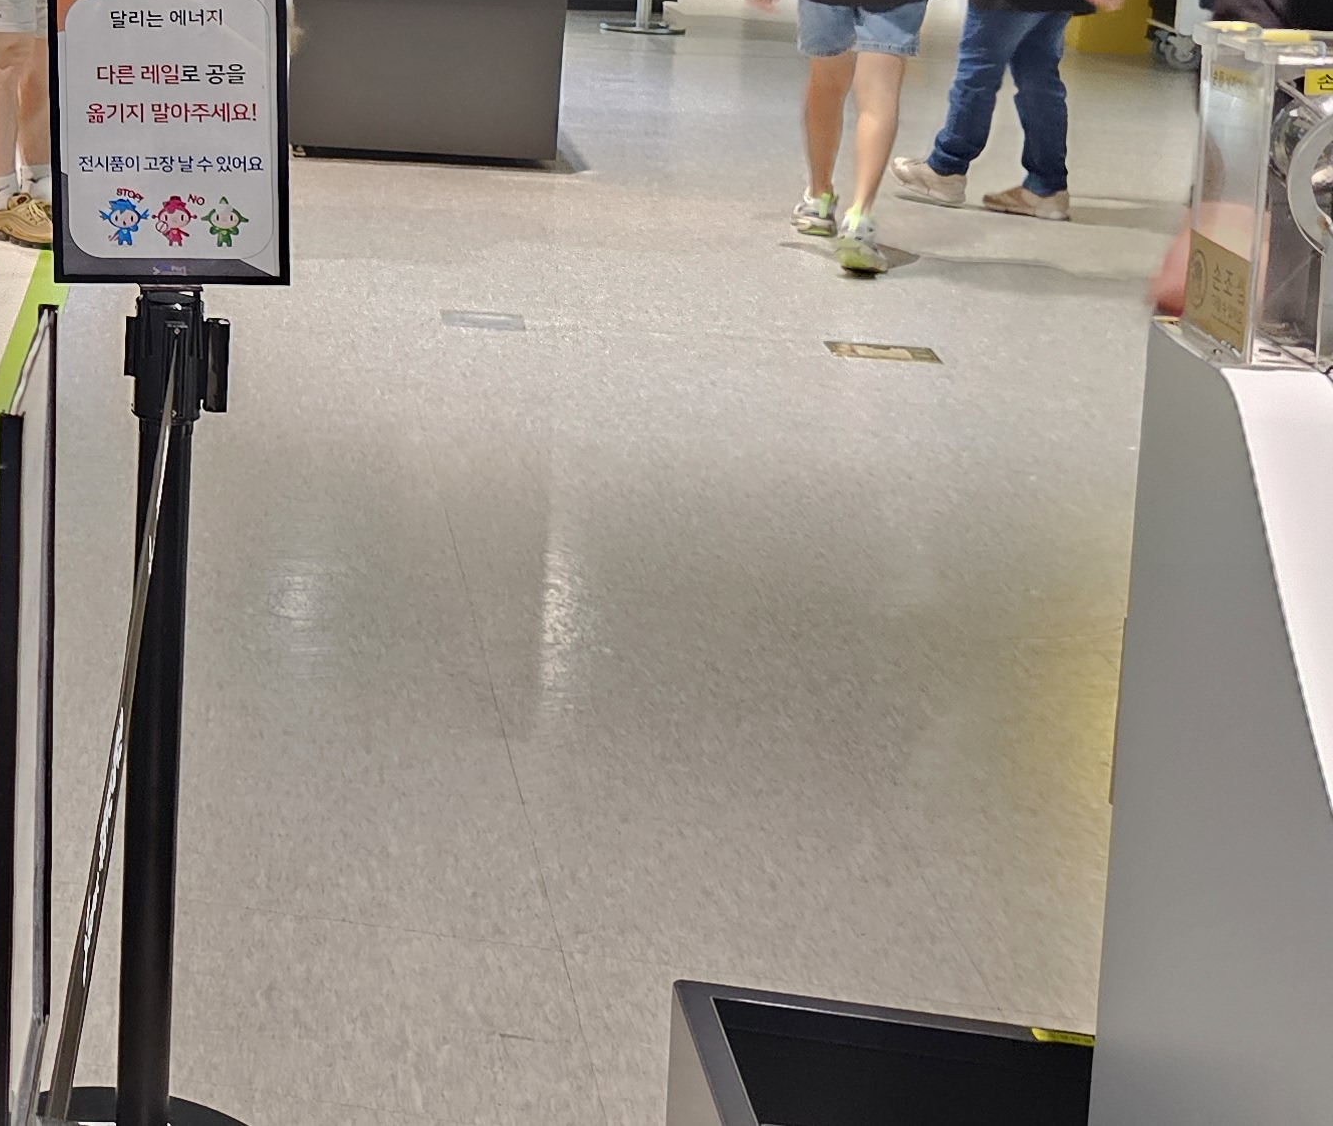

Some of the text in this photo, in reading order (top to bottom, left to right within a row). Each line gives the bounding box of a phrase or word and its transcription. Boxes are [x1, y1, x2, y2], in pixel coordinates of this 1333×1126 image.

[110, 8, 224, 29] 달리는 에너지
[96, 63, 246, 86] 다른 레일로 공을
[1316, 73, 1333, 91] 손
[86, 102, 257, 124] 옮기지 말아주세요!
[78, 155, 264, 174] 전시품이 고장 날 수 있어요
[188, 193, 205, 206] NO
